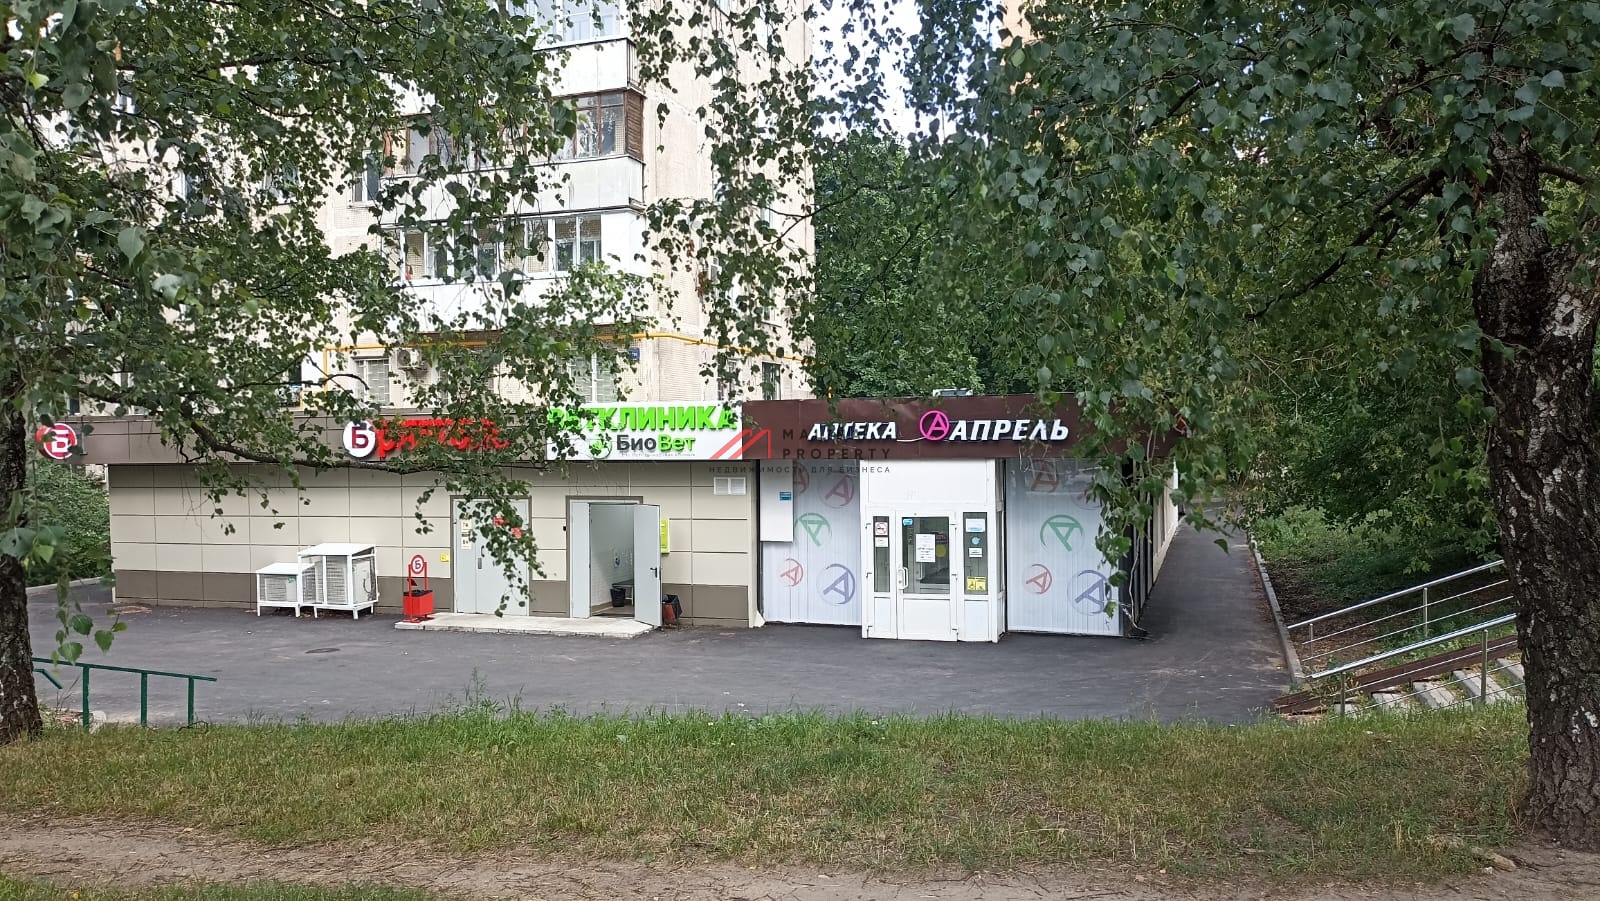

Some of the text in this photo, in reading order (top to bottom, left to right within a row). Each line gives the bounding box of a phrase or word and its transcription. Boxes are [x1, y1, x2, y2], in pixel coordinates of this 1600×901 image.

[807, 421, 896, 441] АПТЕКА
[948, 419, 1069, 441] АПРЕЛЬ
[616, 434, 696, 452] БиоВет
